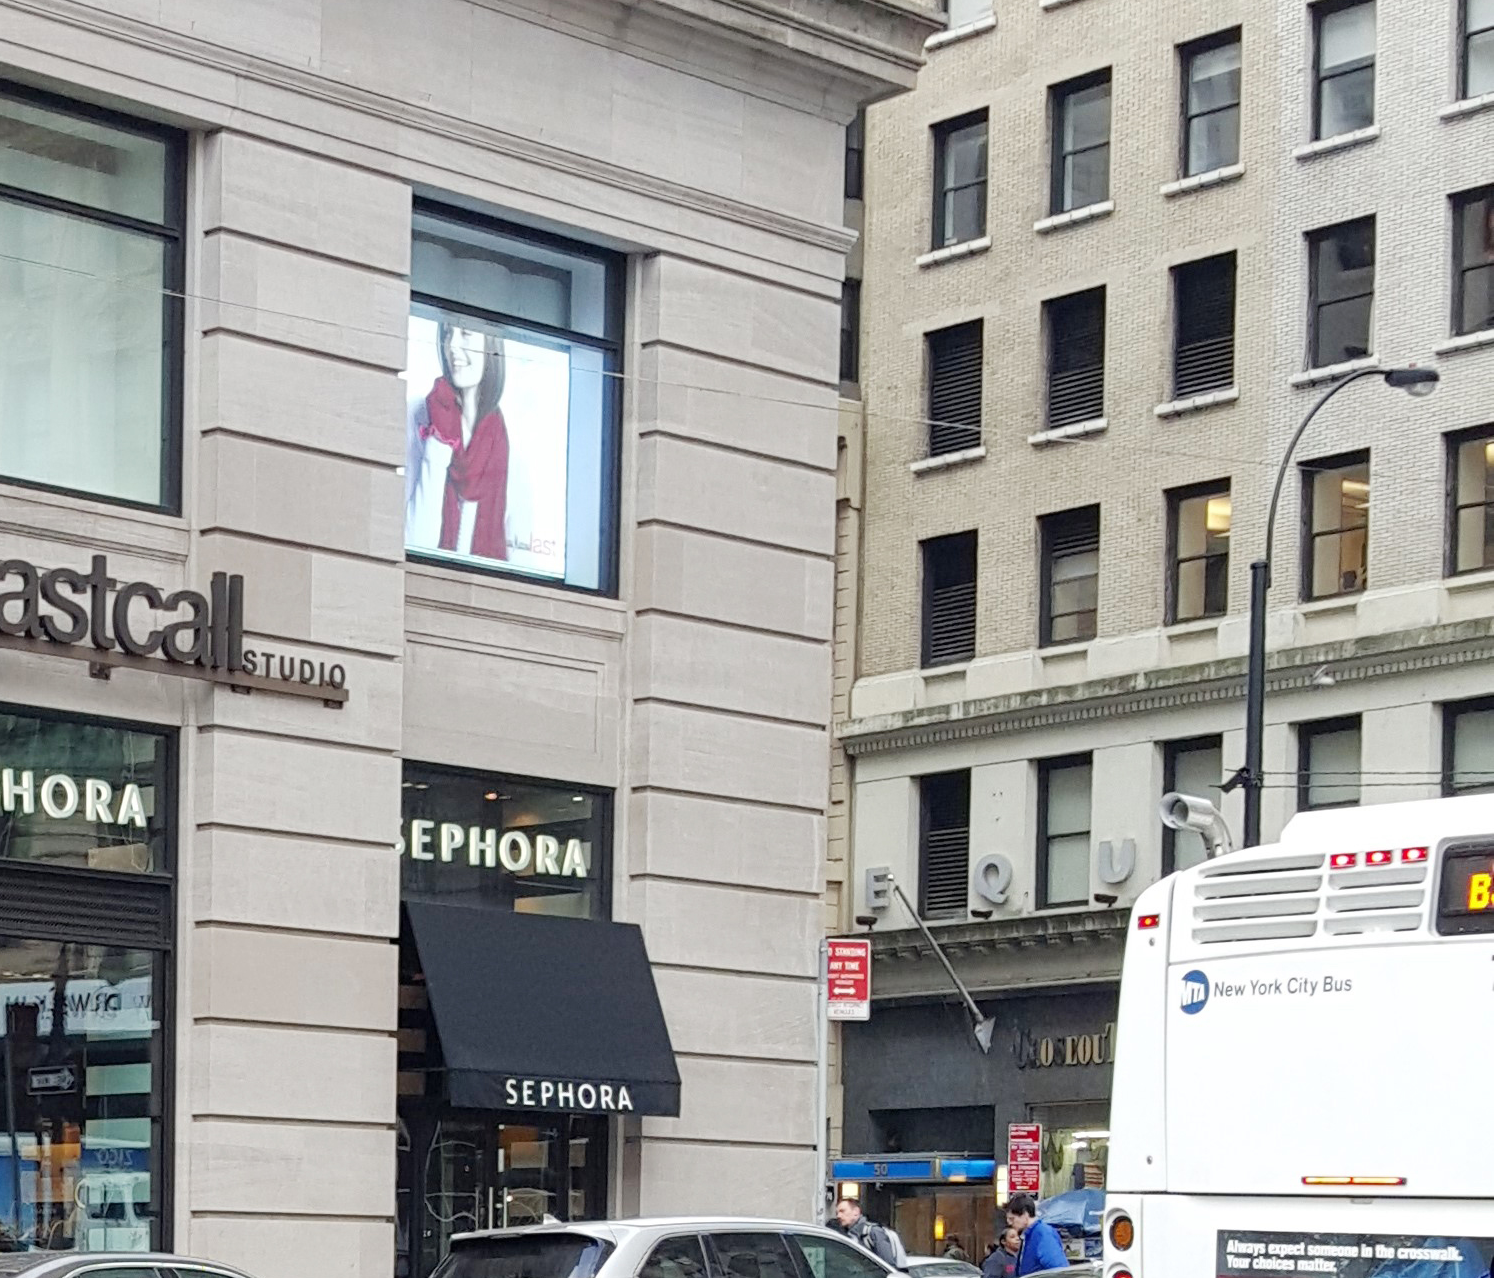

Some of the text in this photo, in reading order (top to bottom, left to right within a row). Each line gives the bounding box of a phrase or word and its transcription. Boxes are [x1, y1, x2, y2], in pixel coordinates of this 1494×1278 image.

[242, 648, 347, 689] STUDIO
[394, 817, 588, 879] EPHORA
[1467, 871, 1494, 911] B
[1213, 981, 1246, 998] New
[1250, 978, 1283, 996] York
[1287, 976, 1319, 997] City
[1322, 975, 1353, 993] Bus
[505, 1077, 634, 1111] SEPHORA
[873, 1163, 889, 1176] 50
[1226, 1239, 1463, 1262] Always expect someone in the crosswalk.
[1226, 1255, 1338, 1273] Your choices matter.
